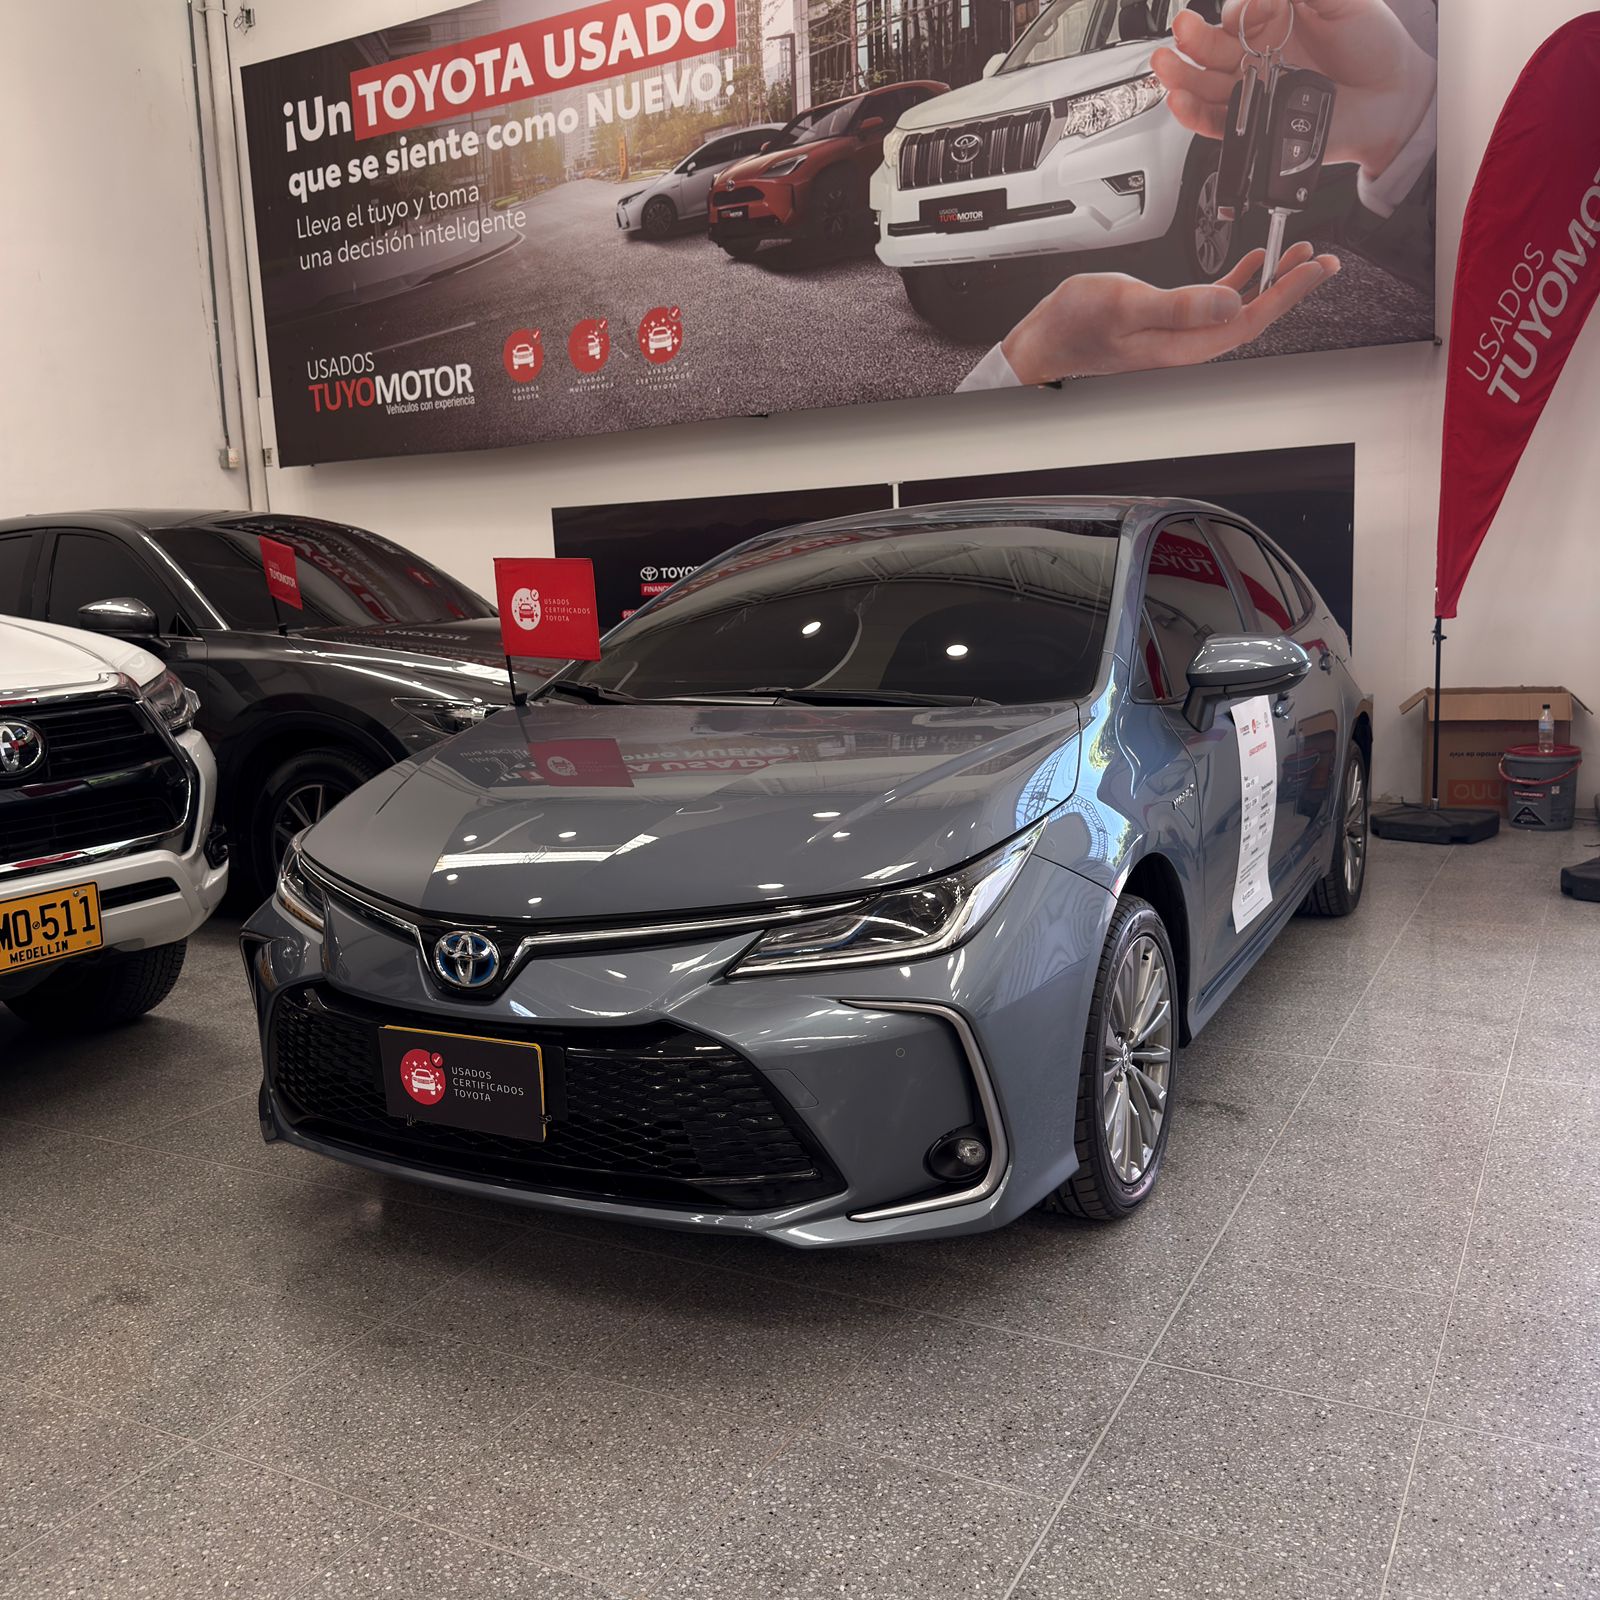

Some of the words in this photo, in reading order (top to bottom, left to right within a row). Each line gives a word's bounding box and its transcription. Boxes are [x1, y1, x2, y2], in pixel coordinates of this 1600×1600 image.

[283, 95, 351, 152] ¡Un
[358, 42, 534, 128] TOYOTA
[543, 0, 726, 80] USADO
[288, 167, 342, 203] que
[348, 156, 381, 185] se
[384, 129, 479, 177] siente
[486, 107, 580, 151] como
[587, 58, 736, 128] NUEVO!
[297, 211, 343, 239] Lleva
[346, 207, 364, 229] el
[367, 198, 410, 230] tuyo
[412, 196, 424, 221] y
[428, 183, 480, 213] toma
[299, 247, 333, 272] una
[337, 228, 415, 264] decisión
[419, 207, 527, 252] inteligente
[1466, 242, 1544, 381] USADOS
[307, 351, 375, 381] USADOS
[308, 363, 475, 413] TUYOMOTOR
[420, 400, 434, 411] con
[434, 394, 476, 410] experiencia
[545, 614, 570, 622] TOYOTA
[9, 939, 69, 965] MEDELLIN
[451, 1066, 492, 1080] USADOS
[452, 1077, 525, 1096] CERTIFICADOS
[453, 1089, 492, 1102] TOYOTA
